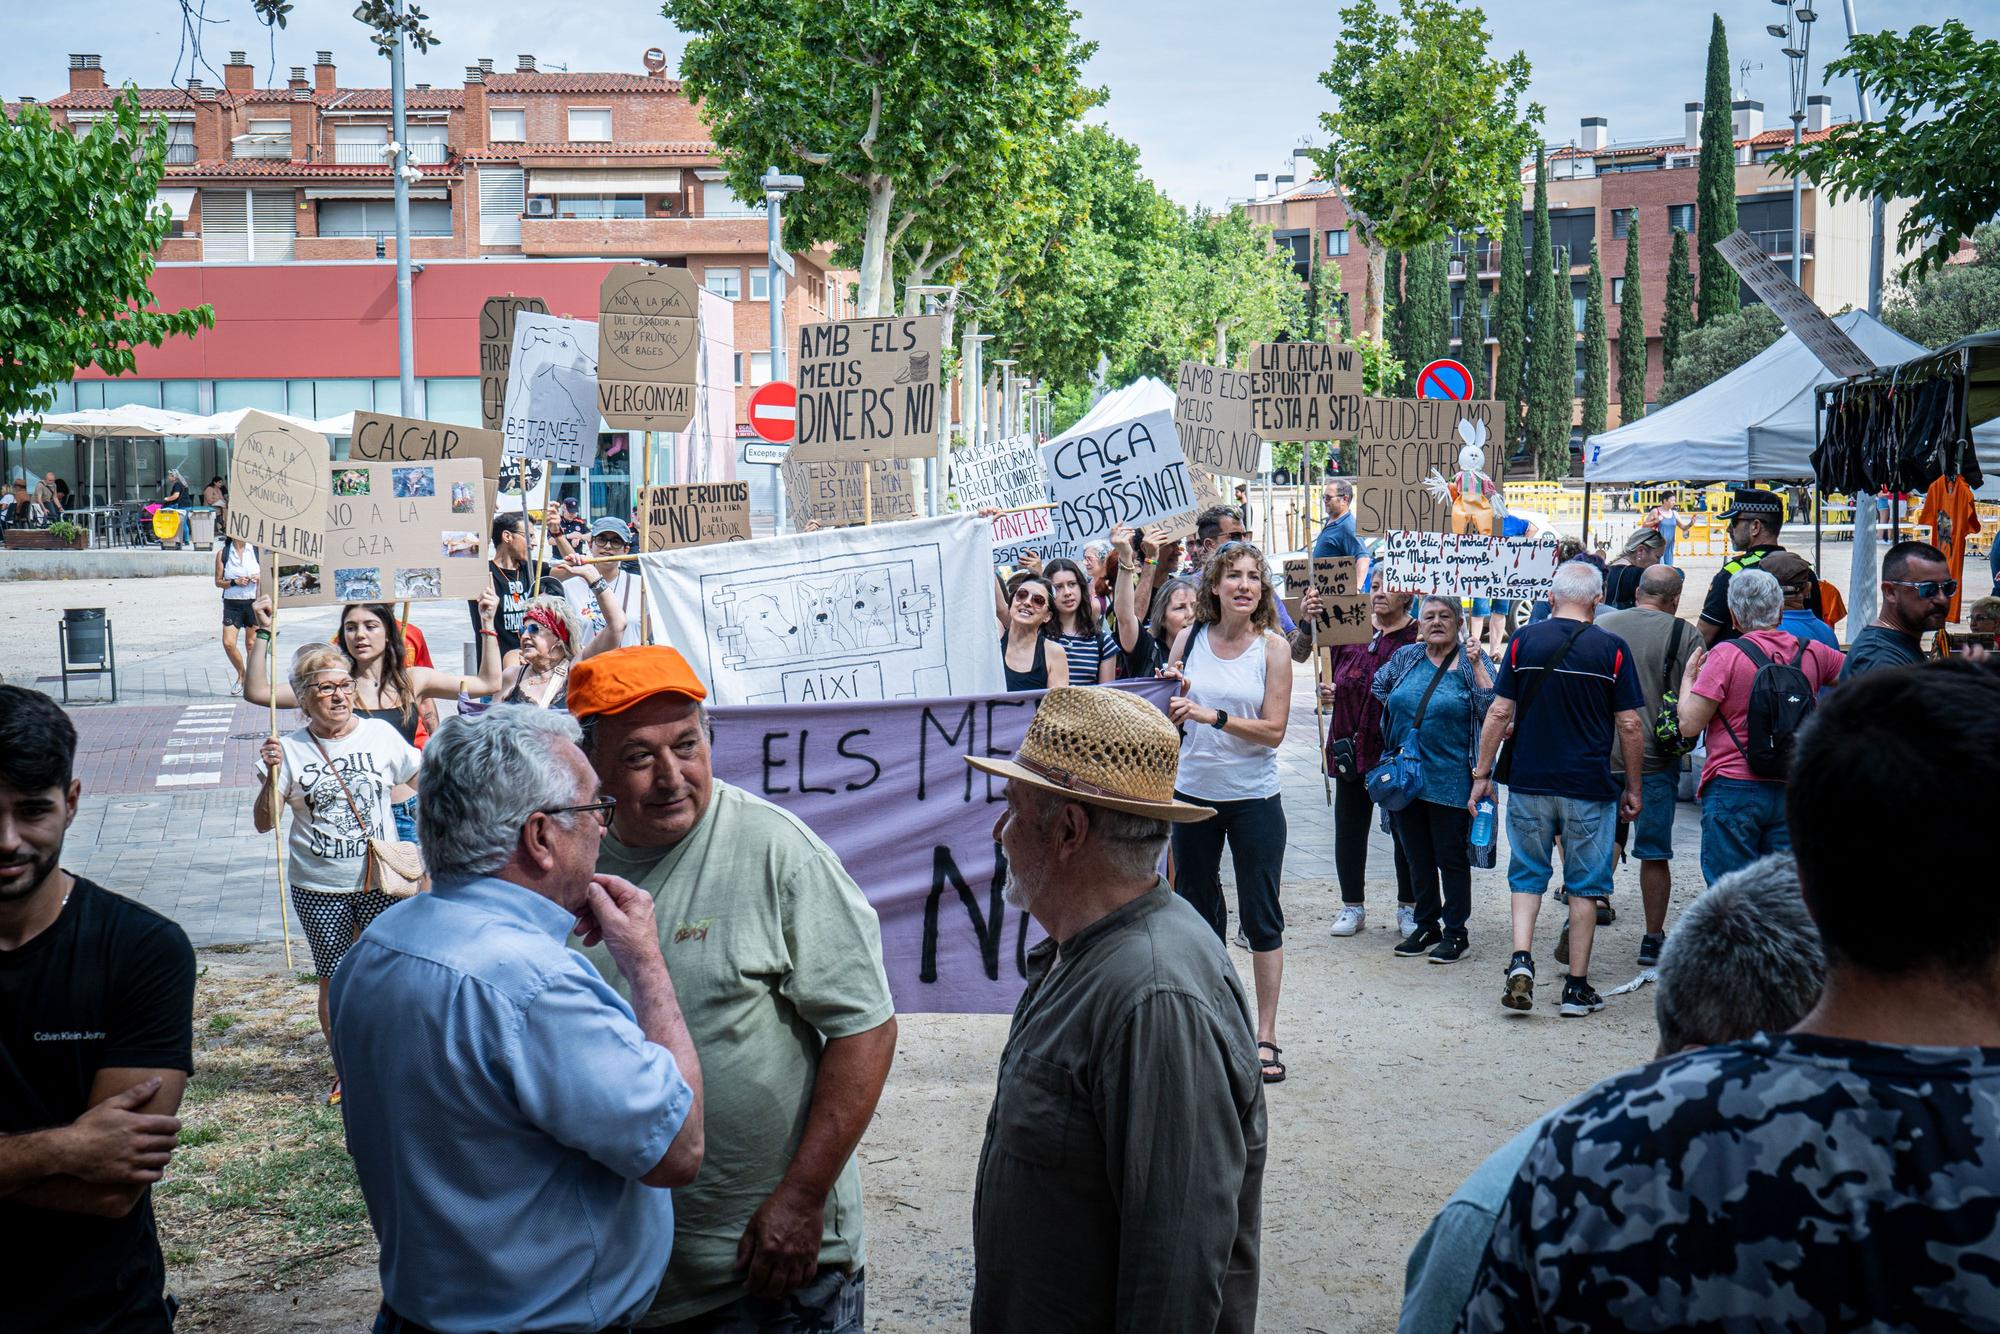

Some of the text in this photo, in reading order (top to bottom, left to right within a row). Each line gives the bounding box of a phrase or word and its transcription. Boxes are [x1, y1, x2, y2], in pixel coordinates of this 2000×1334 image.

[615, 295, 630, 306] NO
[646, 299, 658, 307] LA
[613, 314, 628, 326] DEL
[613, 330, 636, 342] SANT
[620, 345, 664, 356] DE BAGES
[801, 320, 917, 359] AMB ELS
[1261, 344, 1353, 375] LA CAÇA NI
[800, 360, 862, 389] MEUS
[1179, 364, 1250, 401] AMB ELS
[1252, 372, 1333, 395] ESPORT NI
[599, 384, 689, 413] VERGONYA!
[1175, 395, 1213, 424] MEUS
[1252, 394, 1361, 432] FESTA A SFB
[799, 383, 935, 444] DINERS NO
[1360, 400, 1440, 441] AJUDEU
[248, 437, 262, 454] NO
[268, 445, 275, 458] A
[358, 421, 459, 461] CAÇAR
[748, 448, 776, 457] Excepte
[954, 441, 1006, 468] AQUESTA
[1054, 422, 1156, 480] CAÇA
[1174, 422, 1264, 474] DINERS NO!
[508, 466, 532, 476] CAA
[1358, 443, 1398, 477] MES
[956, 466, 973, 485] LA
[687, 482, 748, 505] FRUITOS
[1061, 461, 1189, 541] ASSASSINAT
[371, 503, 383, 524] A
[398, 501, 420, 524] LA
[669, 503, 700, 544] NO
[992, 508, 1049, 542] TANT-LA?
[230, 511, 324, 559] NO A LA FIRA!
[342, 534, 395, 558] CAZA
[1386, 530, 1402, 551] No
[1387, 550, 1406, 565] que
[1485, 585, 1549, 599] ASSASSINA
[763, 699, 1037, 804] ELS ME
[919, 842, 1031, 984] N
[34, 1031, 60, 1041] Calvin
[61, 1031, 82, 1040] Klein
